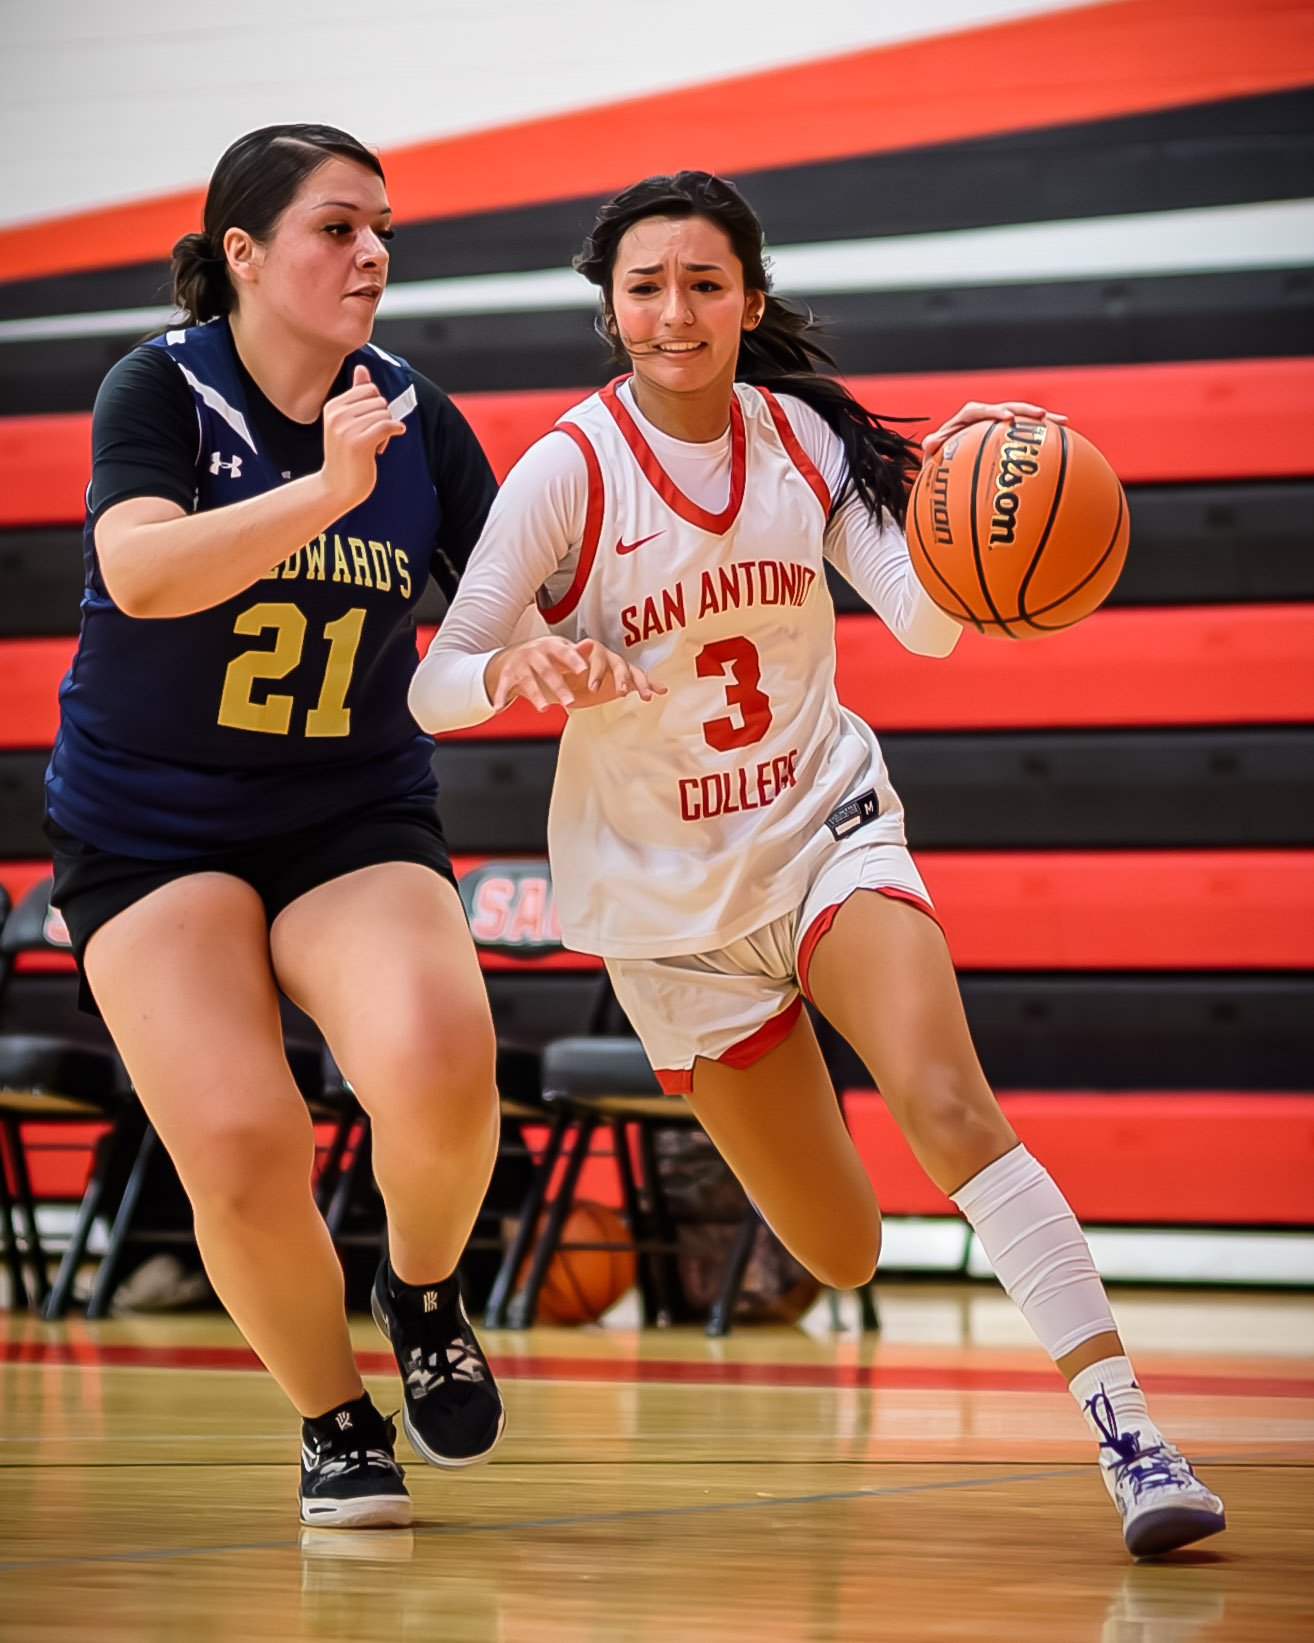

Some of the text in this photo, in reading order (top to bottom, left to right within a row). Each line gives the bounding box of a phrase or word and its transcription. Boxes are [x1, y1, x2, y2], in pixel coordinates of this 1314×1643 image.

[989, 421, 1047, 548] Wilson
[621, 560, 816, 648] SAN ANTONIO
[217, 602, 367, 738] 21
[695, 635, 773, 753] 3
[472, 877, 562, 942] SA
